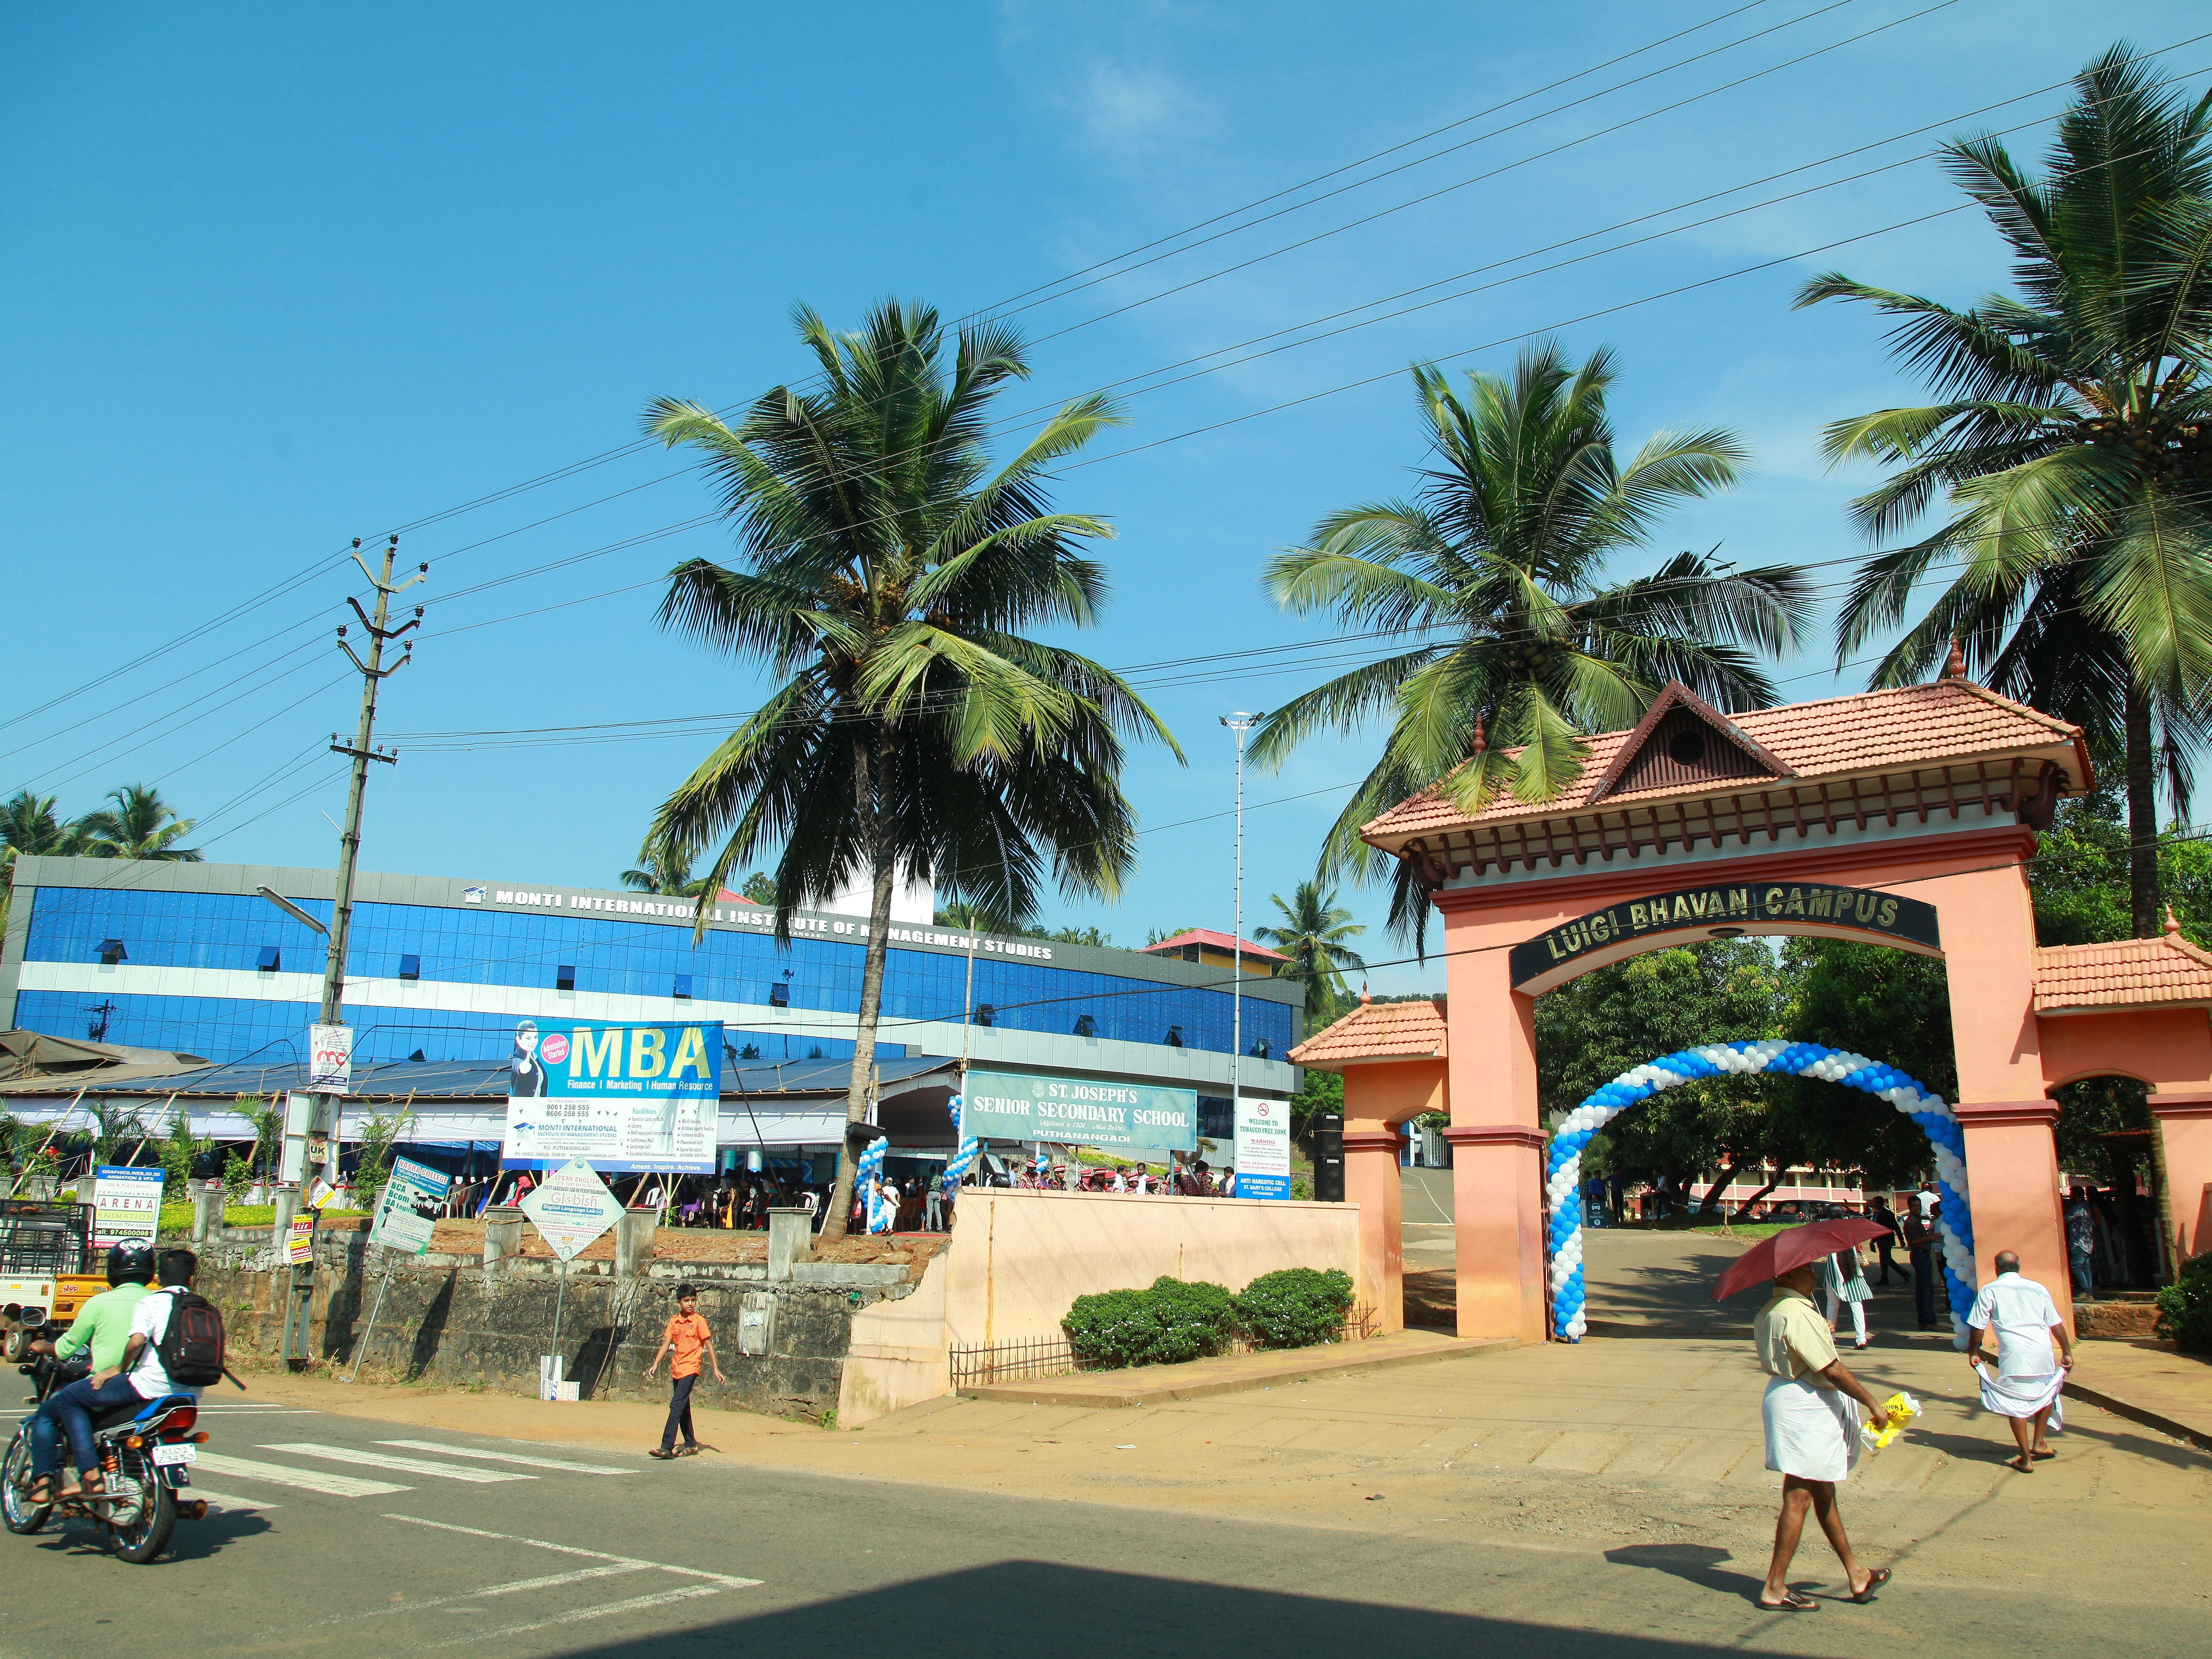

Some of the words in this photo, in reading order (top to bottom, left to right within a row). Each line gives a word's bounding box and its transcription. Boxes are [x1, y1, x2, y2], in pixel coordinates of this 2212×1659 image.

[496, 890, 562, 907] MONTI
[833, 921, 856, 936] OF
[860, 924, 980, 950] MNAGEMENT
[985, 939, 1052, 960] STUDIES
[1546, 910, 1620, 960] LUIGI
[1630, 888, 1748, 931] BHAVAN
[1765, 887, 1899, 927] CAMPUS
[759, 927, 824, 939] PUTNANGADI
[543, 1039, 567, 1054] Admission
[569, 1027, 712, 1079] MBA
[548, 1048, 565, 1059] Started
[567, 1079, 596, 1089] Finance
[606, 1080, 642, 1092] Marketing
[651, 1081, 677, 1090] Human
[679, 1081, 713, 1091] Resource
[1048, 1083, 1067, 1098] ST.
[1071, 1085, 1138, 1103] JOSEPH'S
[973, 1096, 1030, 1115] SENIOR
[1037, 1102, 1127, 1123] SECONDARY
[1133, 1109, 1190, 1127] SCHOOL
[1032, 1129, 1130, 1142] PUTHANANGADI
[311, 1145, 326, 1155] UK
[397, 1168, 420, 1179] TIRURKAD
[398, 1160, 421, 1174] NASRA
[421, 1168, 448, 1184] COLLEGE
[391, 1181, 406, 1193] BCA
[100, 1198, 153, 1209] ARENA
[551, 1192, 598, 1207] Globish
[385, 1198, 395, 1207] BA
[396, 1203, 417, 1215] English
[63, 1284, 78, 1293] Stop
[156, 1454, 195, 1464] Z3450
